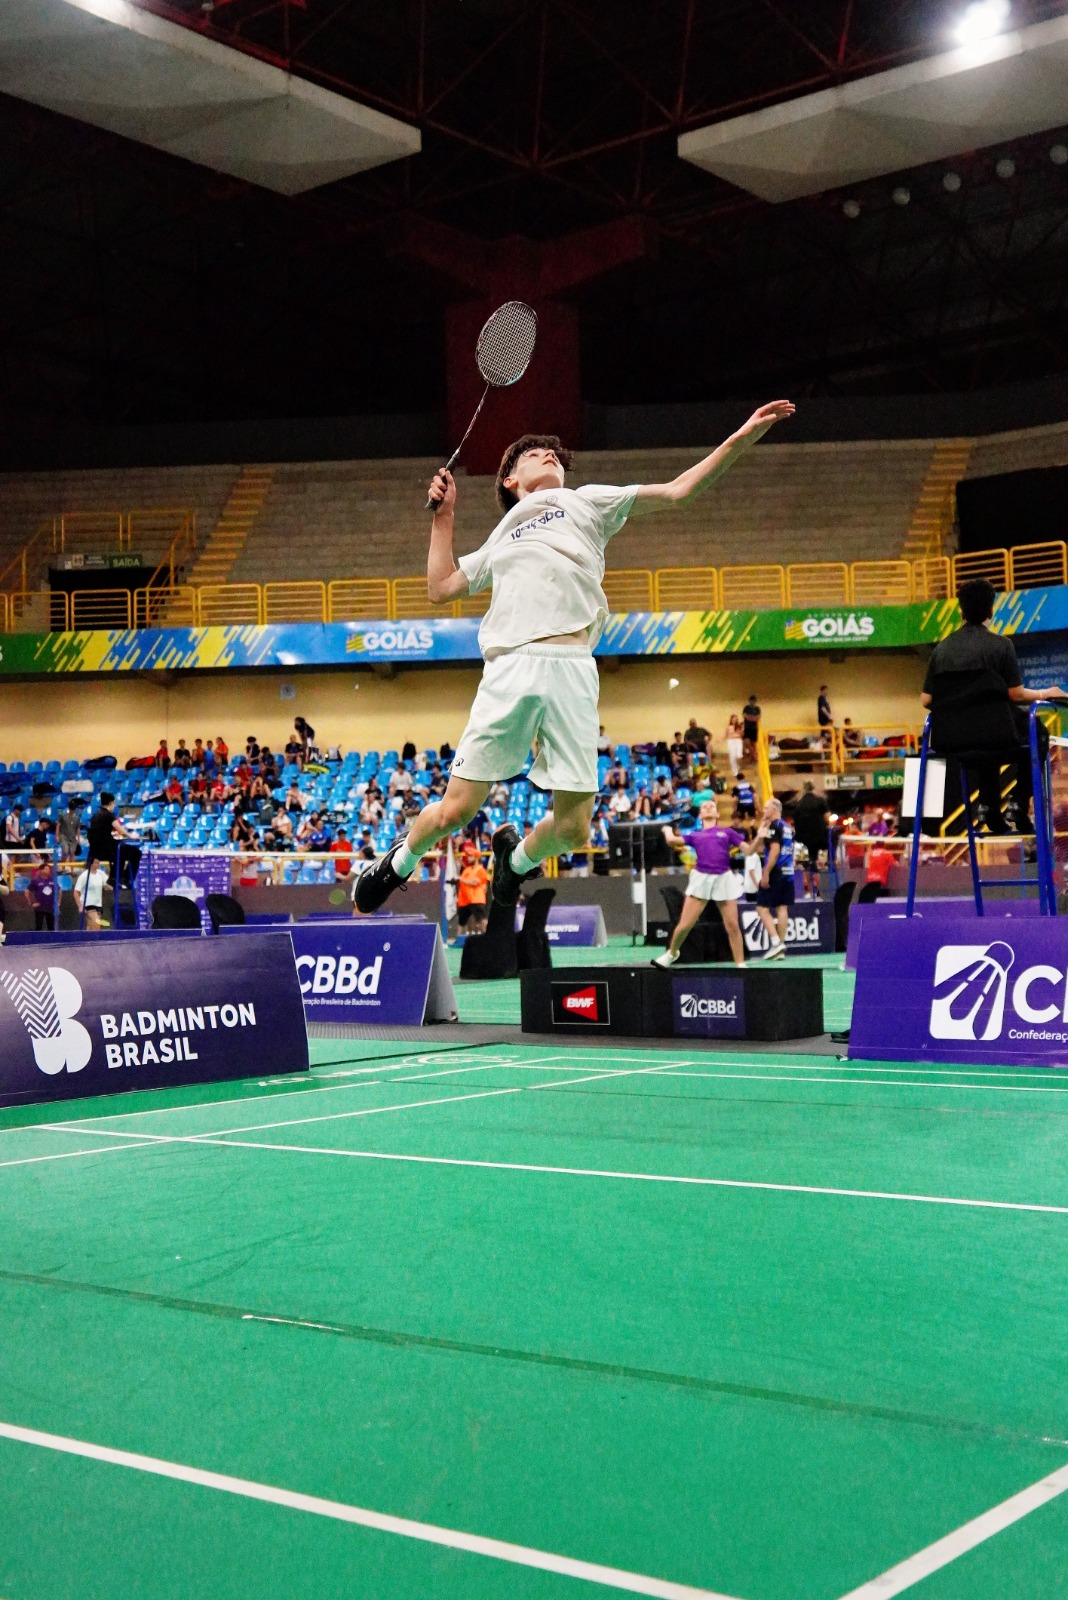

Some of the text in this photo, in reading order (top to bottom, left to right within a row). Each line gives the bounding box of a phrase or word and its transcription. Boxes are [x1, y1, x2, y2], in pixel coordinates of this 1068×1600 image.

[801, 613, 874, 637] GOIÁS
[362, 627, 434, 650] GOIÁS
[772, 916, 820, 942] BBd
[566, 997, 595, 1008] BWF
[1012, 964, 1068, 1024] C
[100, 1002, 257, 1039] BADMINTON
[105, 1036, 199, 1069] BRASIL
